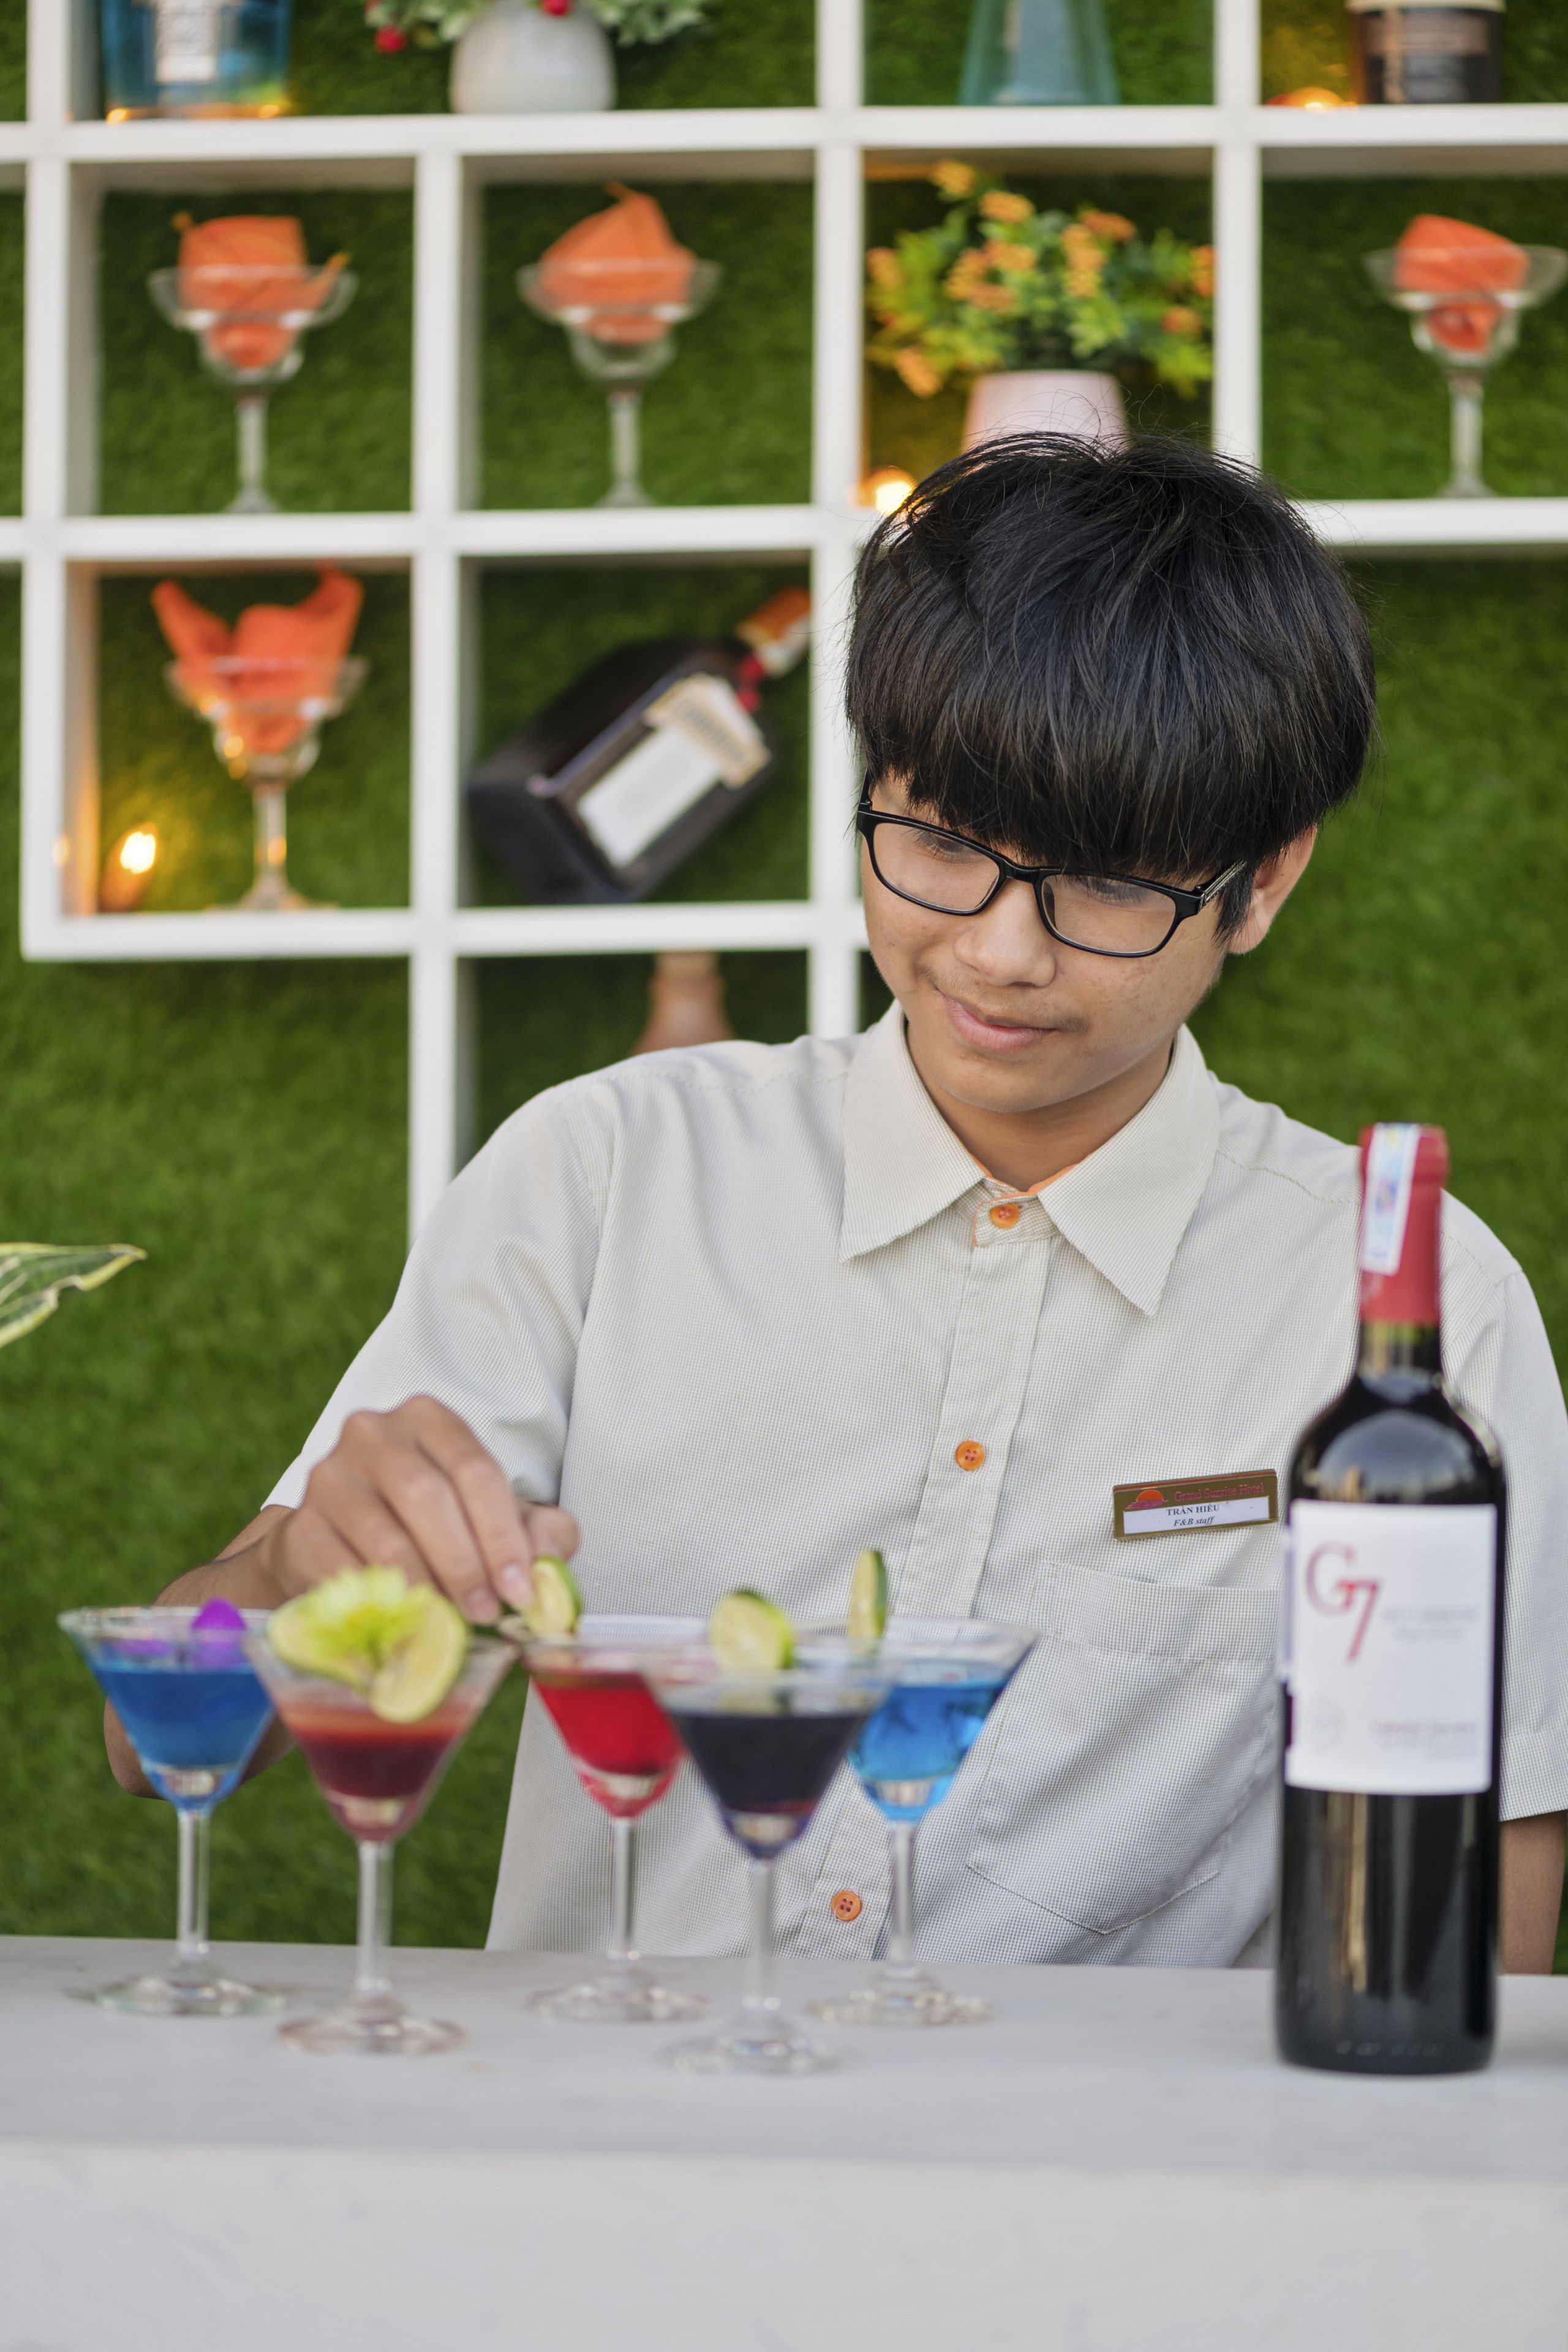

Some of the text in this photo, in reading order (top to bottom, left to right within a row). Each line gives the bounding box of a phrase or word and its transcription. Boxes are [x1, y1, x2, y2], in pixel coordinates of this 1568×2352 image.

[1174, 1482, 1265, 1502] Grand Sunrise Hotel
[1174, 1516, 1215, 1526] F&B staff
